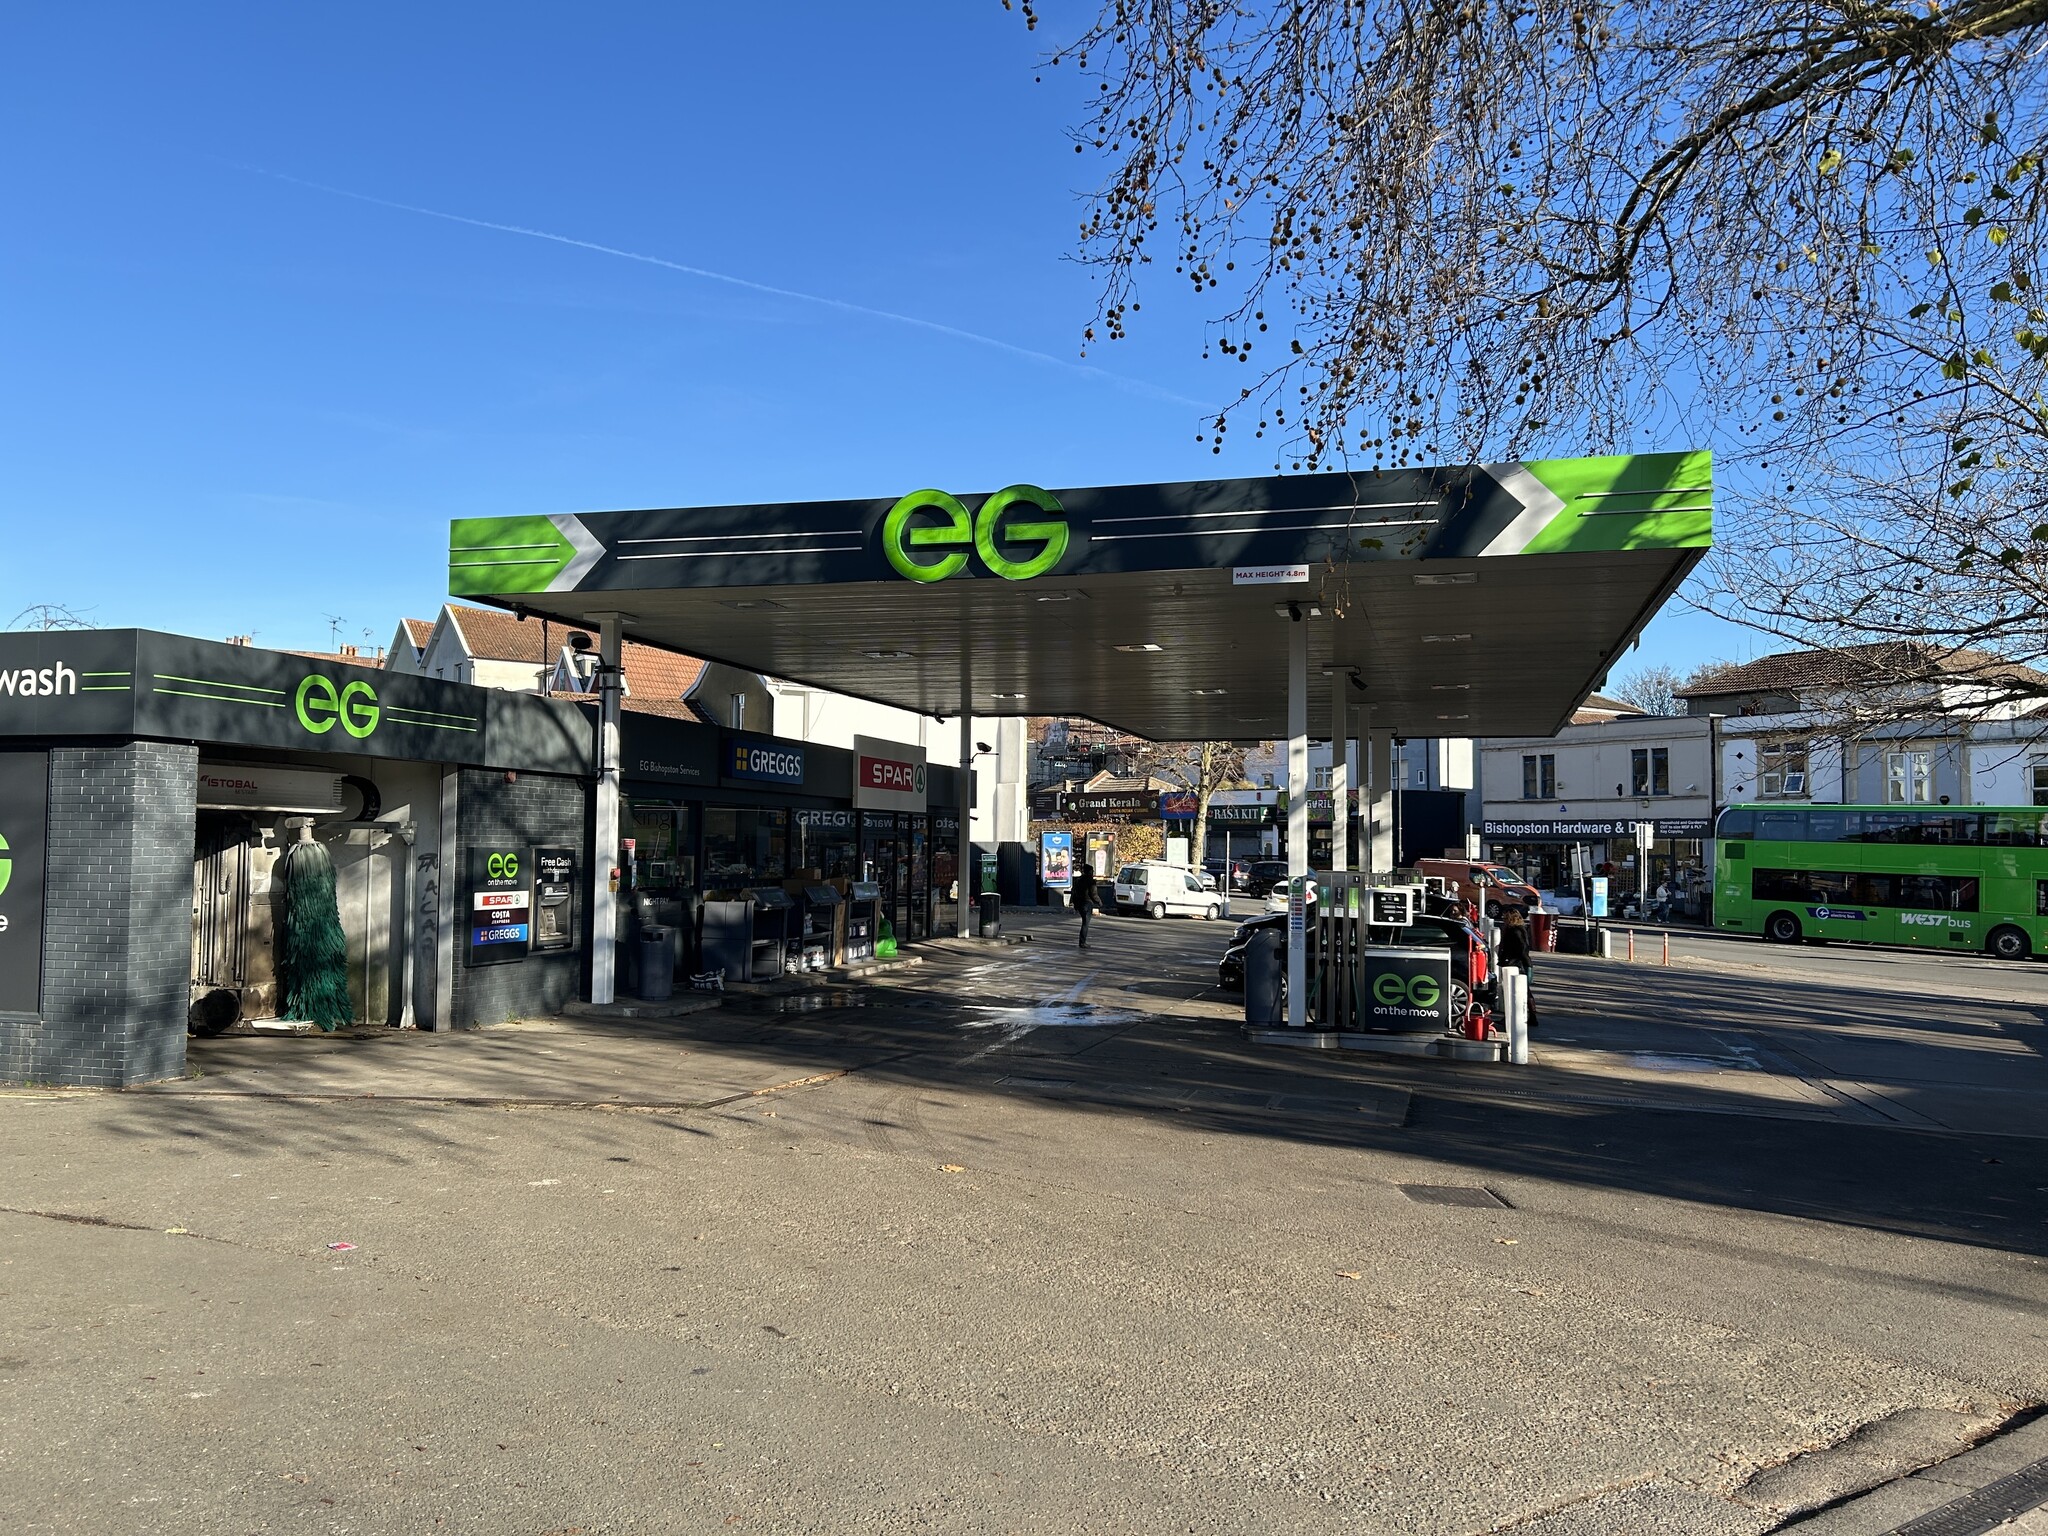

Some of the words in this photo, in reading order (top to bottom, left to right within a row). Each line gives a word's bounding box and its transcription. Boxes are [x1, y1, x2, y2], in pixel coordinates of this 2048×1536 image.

[1255, 570, 1285, 578] HEIGHT
[639, 759, 649, 771] EG
[650, 761, 679, 777] Bishopston
[679, 764, 700, 776] Services
[750, 749, 801, 777] GREGGS
[872, 763, 913, 787] SPAR
[207, 778, 258, 789] ISTOBAL
[1078, 798, 1107, 808] Grand
[1108, 797, 1141, 808] Kerala
[1214, 808, 1240, 819] RASA
[1241, 808, 1259, 819] KIT
[1485, 822, 1550, 836] Bishopston
[1552, 822, 1612, 834] Hardware
[1615, 822, 1625, 834] &
[541, 857, 556, 867] Free
[556, 857, 572, 867] Cash
[488, 895, 513, 905] SPAR
[643, 897, 659, 906] NIGHT
[660, 896, 670, 905] PAY
[491, 910, 510, 919] COSTA
[488, 928, 520, 941] GREGGS
[1373, 1006, 1388, 1015] on
[1388, 1005, 1408, 1016] the
[1408, 1009, 1440, 1018] move
